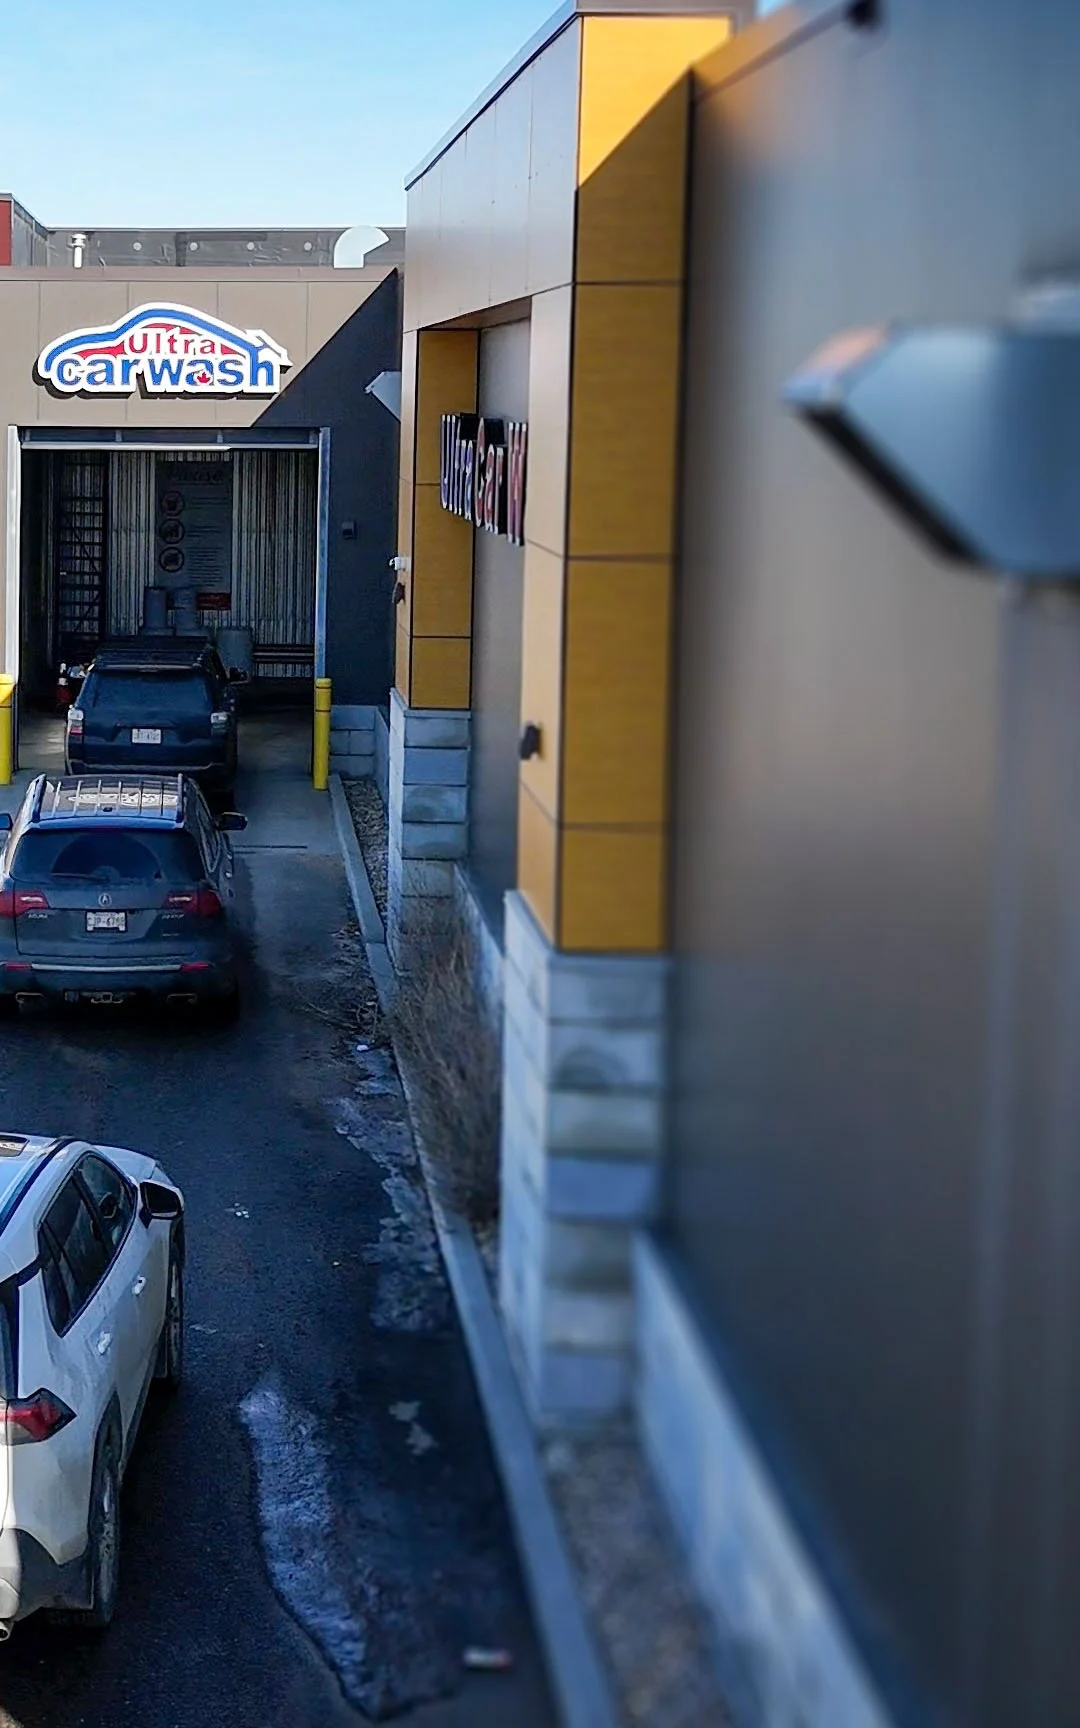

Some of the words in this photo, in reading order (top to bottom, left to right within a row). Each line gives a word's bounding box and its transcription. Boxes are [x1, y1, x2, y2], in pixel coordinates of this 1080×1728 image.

[128, 332, 216, 354] Ultra
[440, 413, 473, 522] Ultra
[474, 416, 504, 535] Car
